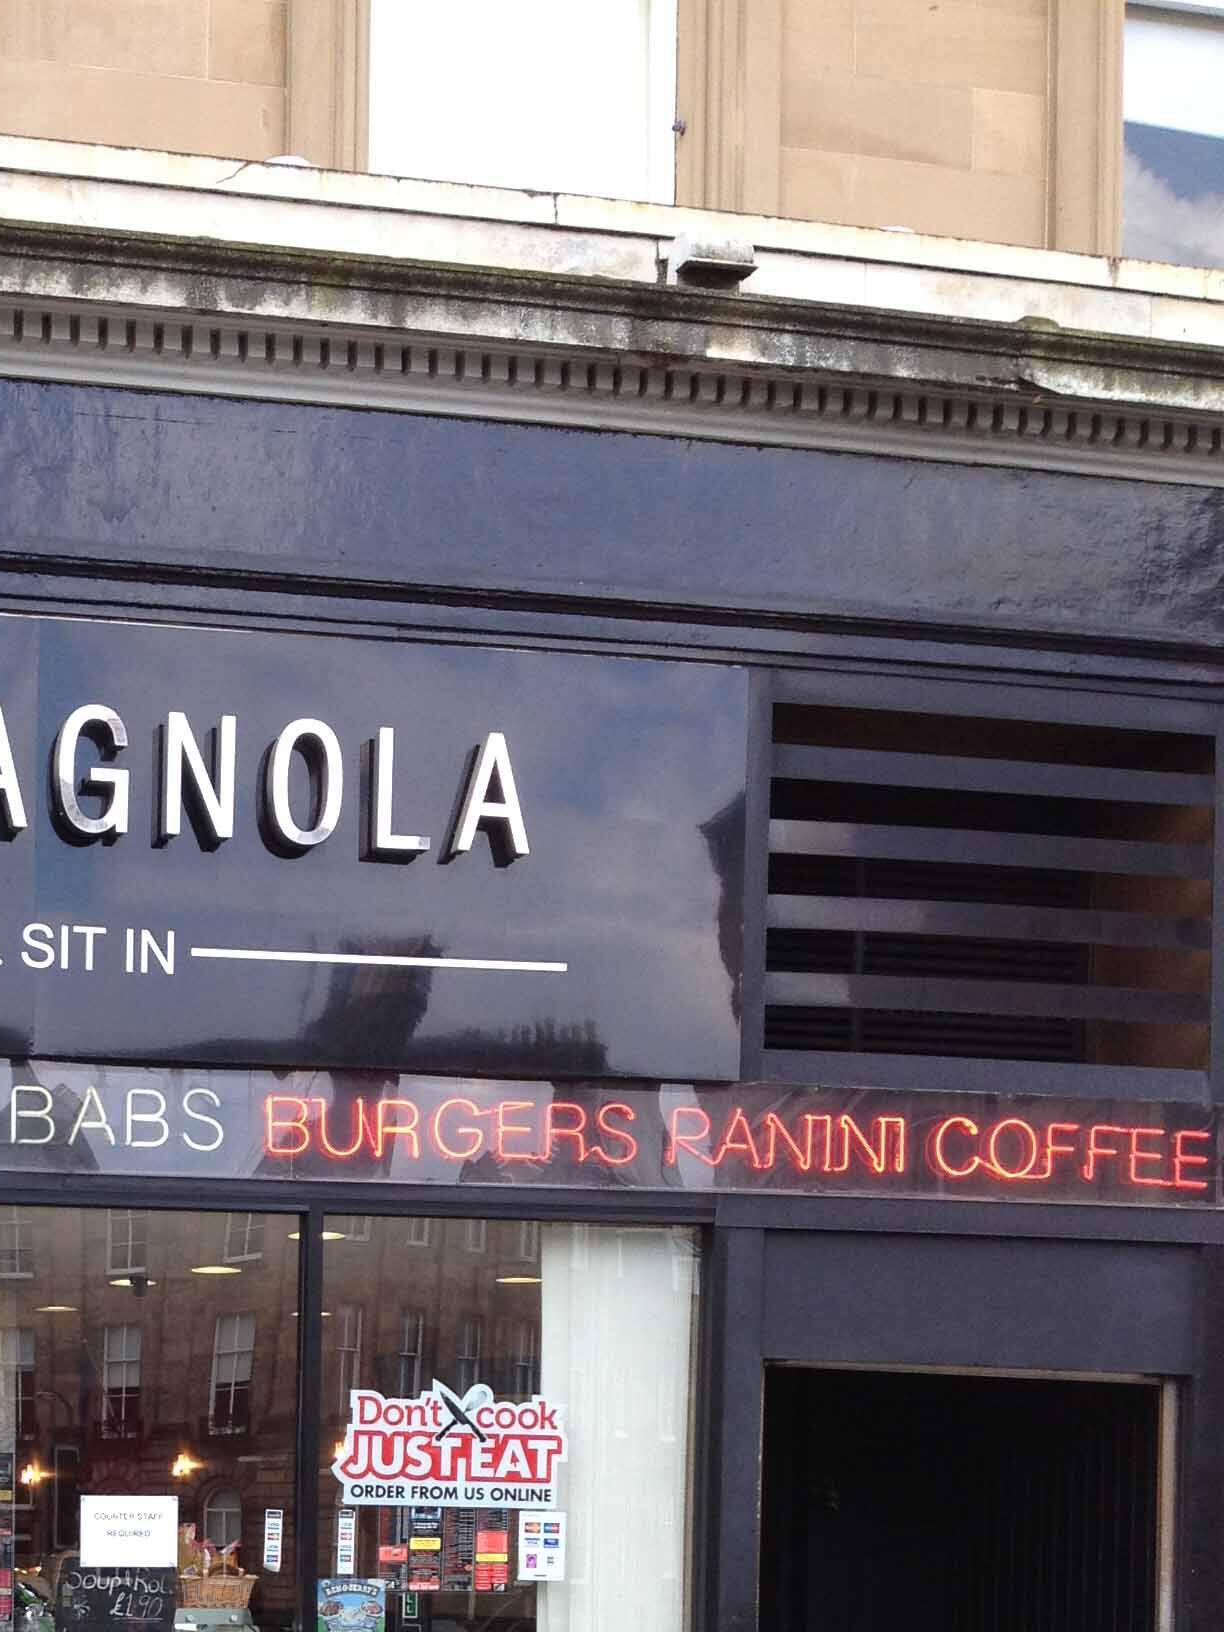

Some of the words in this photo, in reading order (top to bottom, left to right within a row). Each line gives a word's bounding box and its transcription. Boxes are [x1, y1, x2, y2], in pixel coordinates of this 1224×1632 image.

[21, 921, 108, 972] SIT
[125, 927, 177, 975] IN
[264, 1094, 639, 1165] BURGERS
[934, 1115, 1212, 1190] COFFEE
[357, 1395, 442, 1428] Don't
[475, 1401, 558, 1430] cook
[345, 1434, 462, 1479] JUST
[471, 1437, 559, 1479] EAT
[350, 1484, 405, 1500] ORDER
[411, 1484, 458, 1500] FROM
[464, 1486, 485, 1501] US
[490, 1487, 552, 1503] ONLINE
